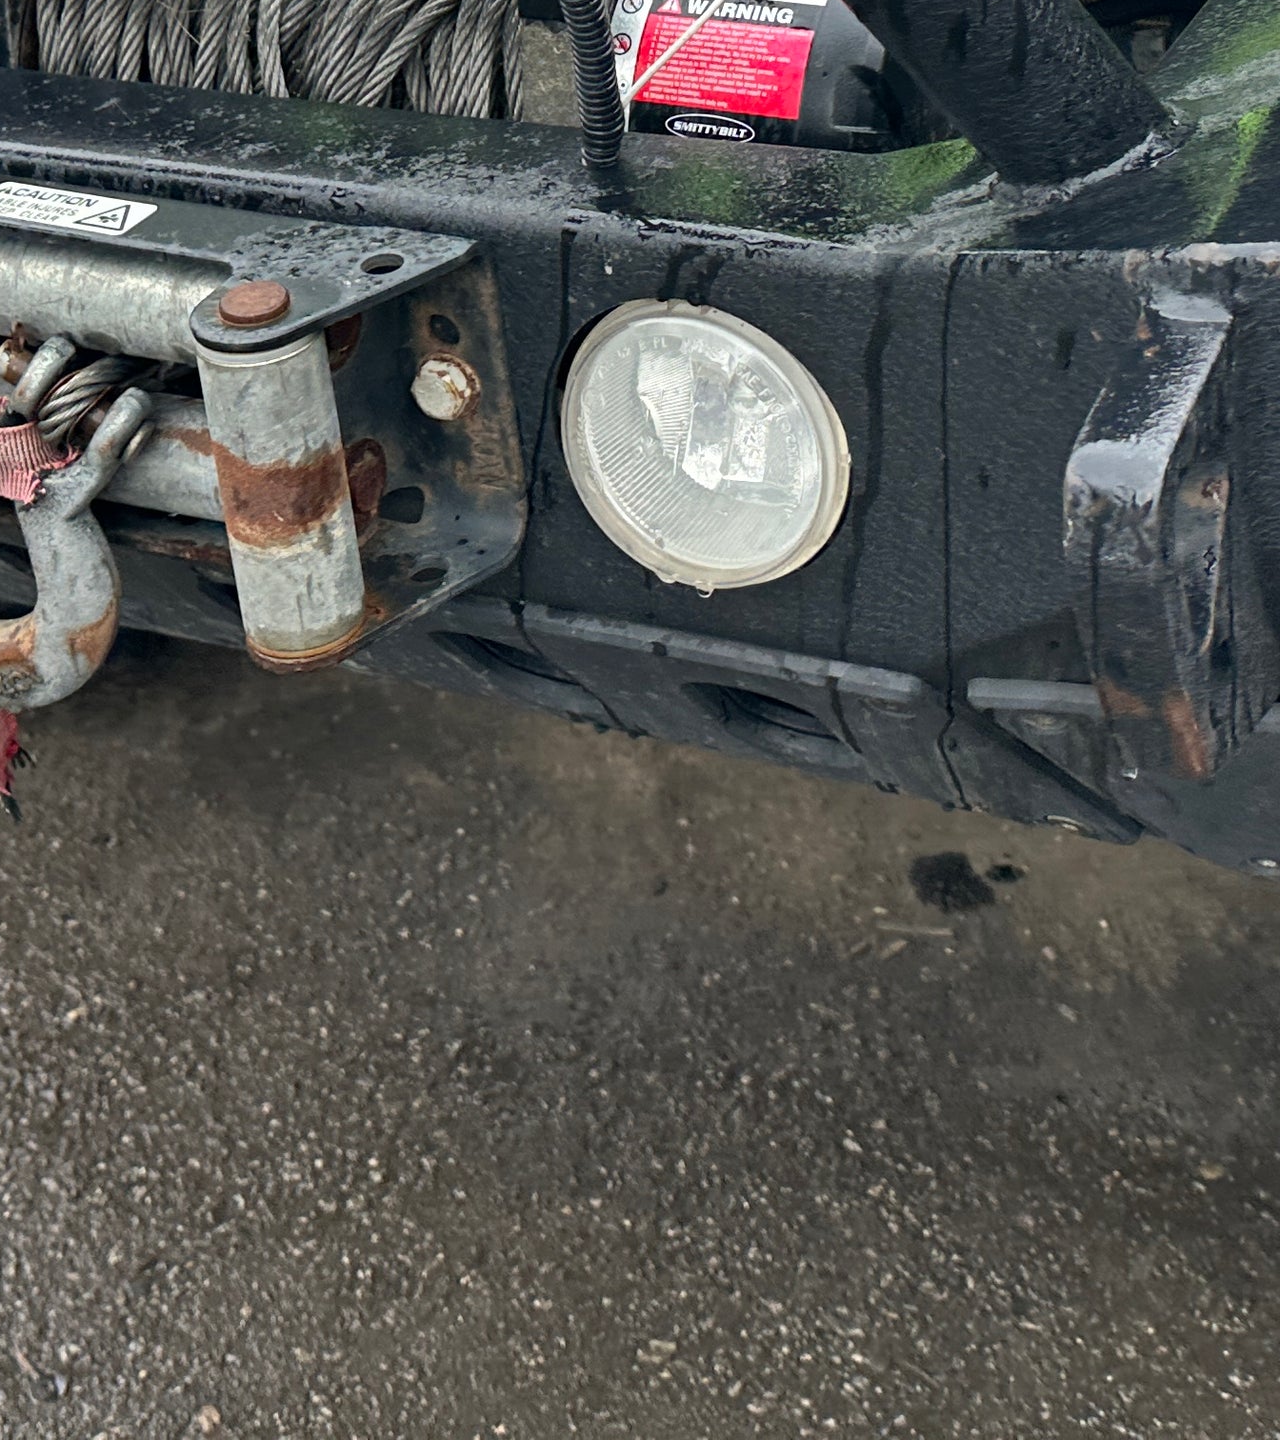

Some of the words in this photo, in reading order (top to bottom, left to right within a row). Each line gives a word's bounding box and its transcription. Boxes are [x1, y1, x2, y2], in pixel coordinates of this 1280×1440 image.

[672, 120, 748, 138] SMITTYBILT
[12, 187, 99, 208] CAUTION
[19, 210, 60, 222] CLEAR
